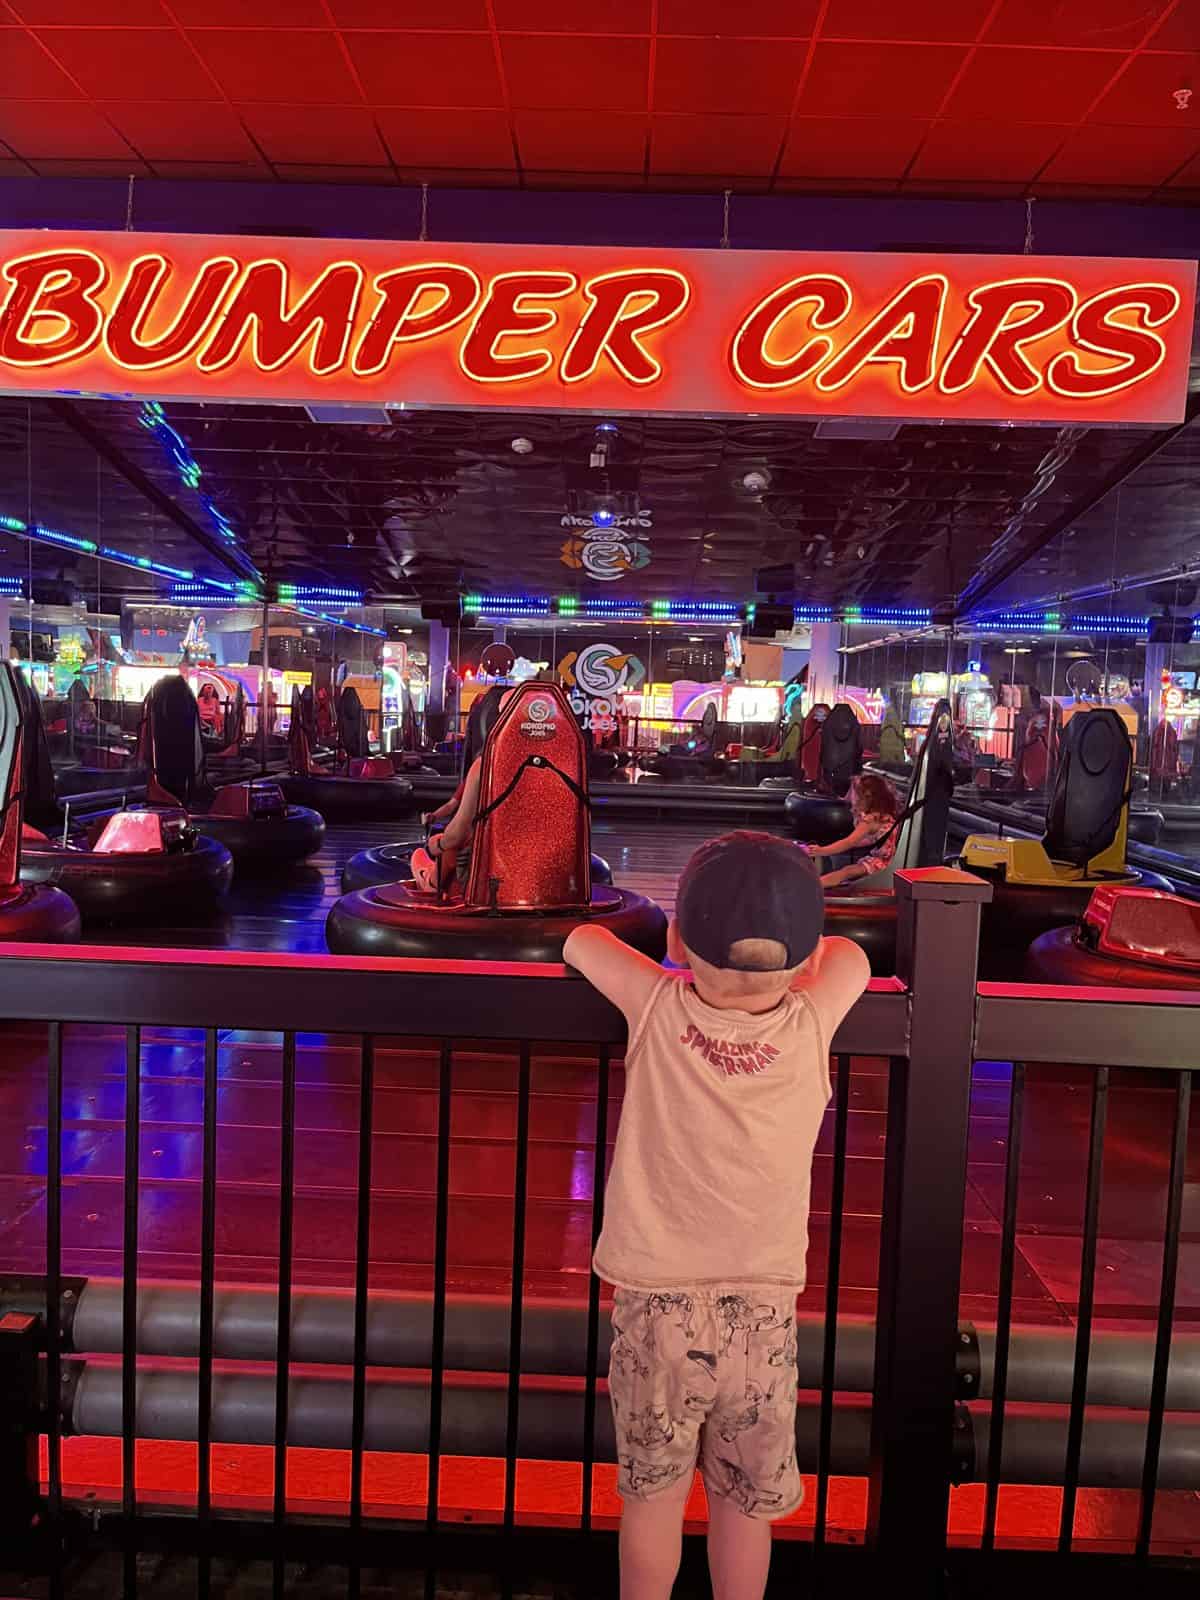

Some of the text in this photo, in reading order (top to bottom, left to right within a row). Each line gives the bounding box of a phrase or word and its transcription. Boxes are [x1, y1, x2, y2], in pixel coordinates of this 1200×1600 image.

[0, 249, 1181, 398] BUMPER CARS
[568, 694, 642, 717] OKOMO
